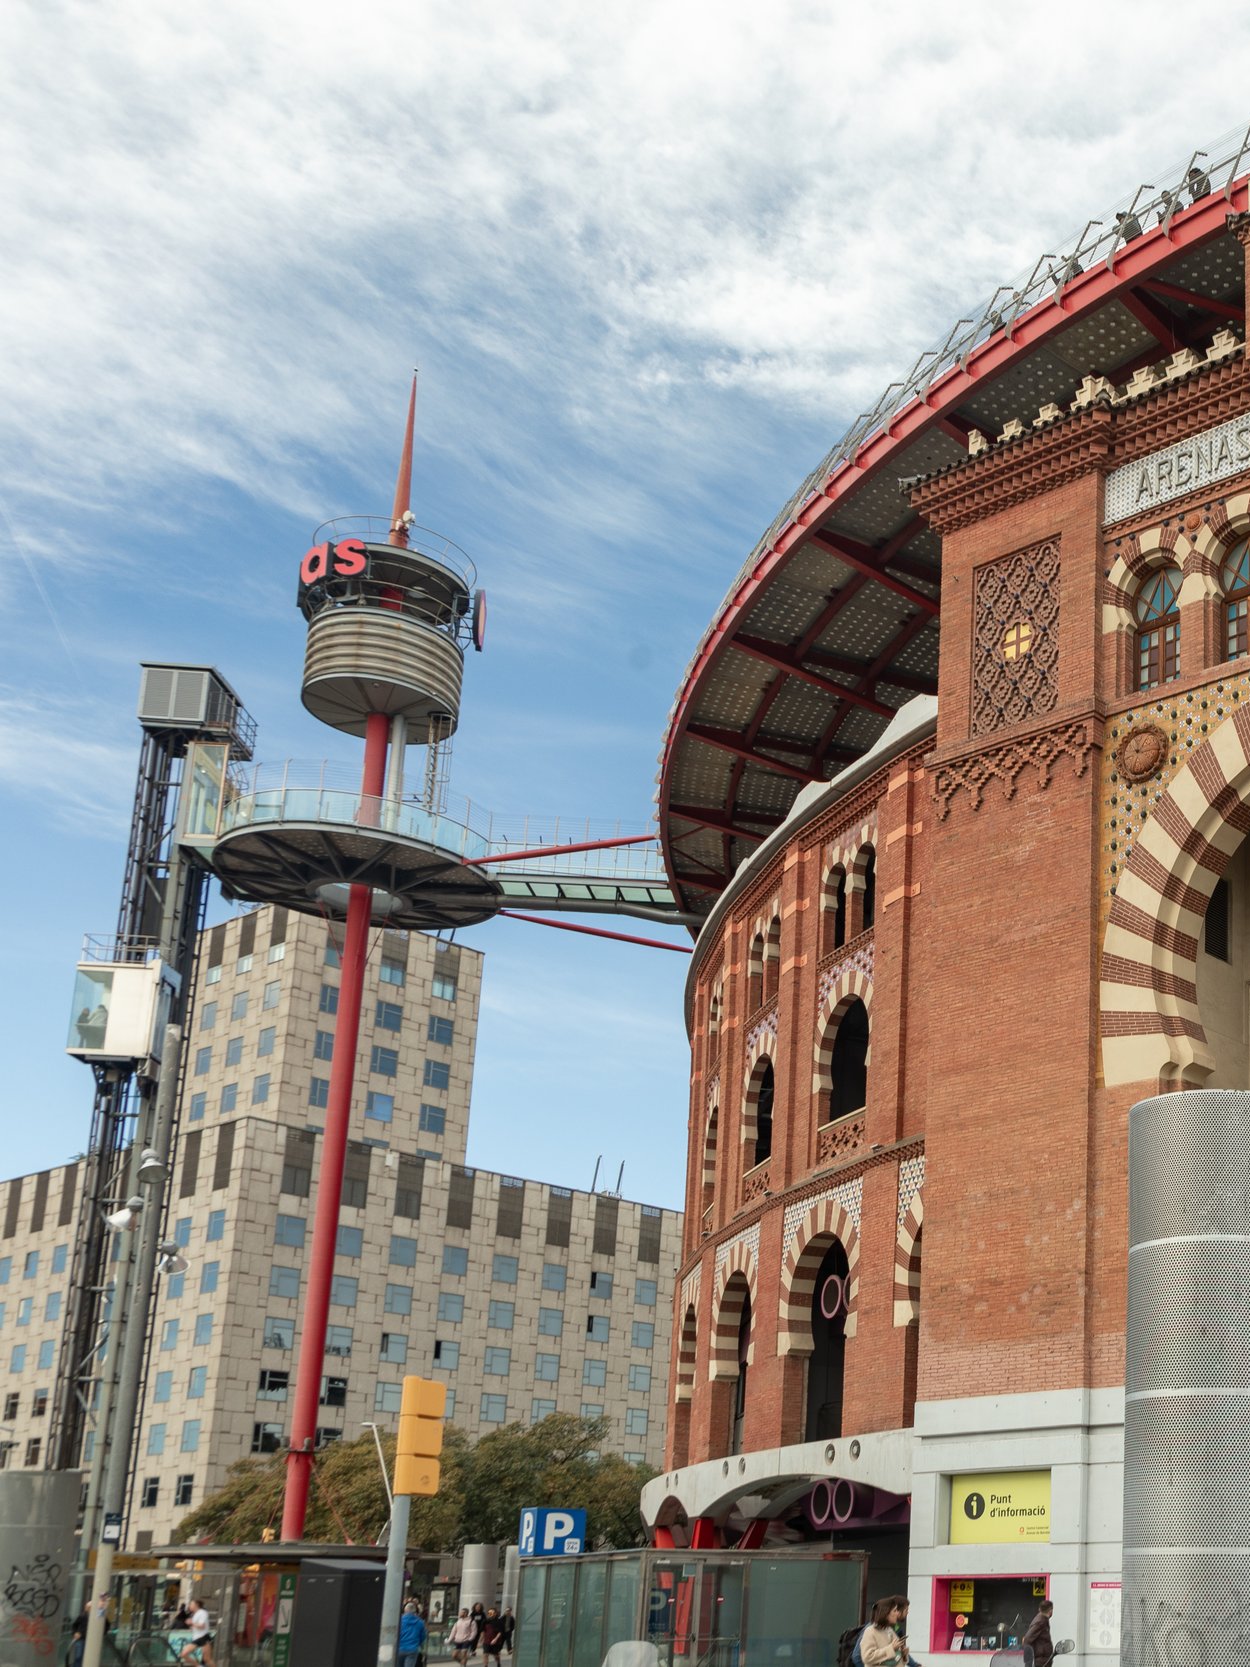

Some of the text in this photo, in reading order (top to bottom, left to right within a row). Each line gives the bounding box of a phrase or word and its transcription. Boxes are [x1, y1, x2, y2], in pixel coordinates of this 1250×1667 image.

[990, 1494, 1011, 1504] Punt
[521, 1512, 533, 1549] P
[544, 1512, 574, 1550] P
